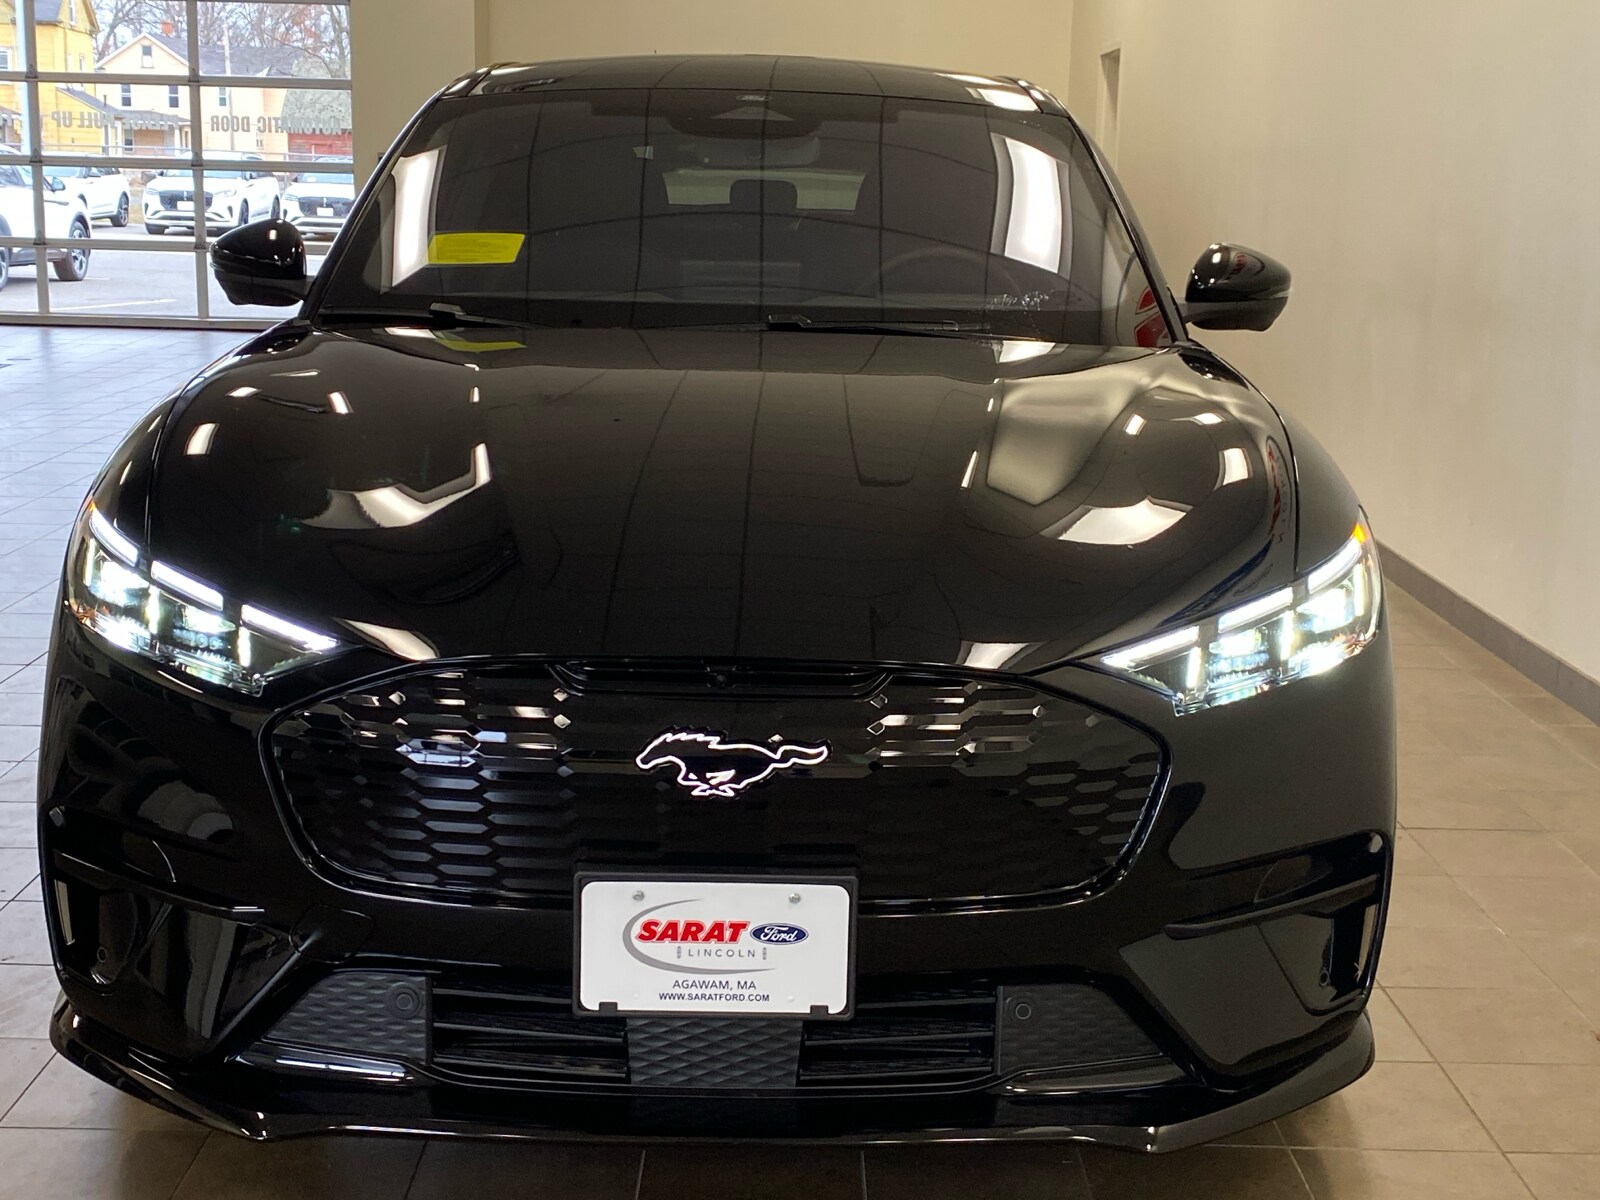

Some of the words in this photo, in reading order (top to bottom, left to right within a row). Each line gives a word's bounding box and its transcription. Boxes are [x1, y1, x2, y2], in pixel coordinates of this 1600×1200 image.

[635, 919, 750, 944] SARAT
[759, 925, 799, 942] Ford
[688, 948, 756, 958] LINCOLN
[672, 980, 733, 991] AGAWAM,
[737, 980, 757, 990] MA
[659, 992, 770, 1002] WWW.SARATFORD.COM
